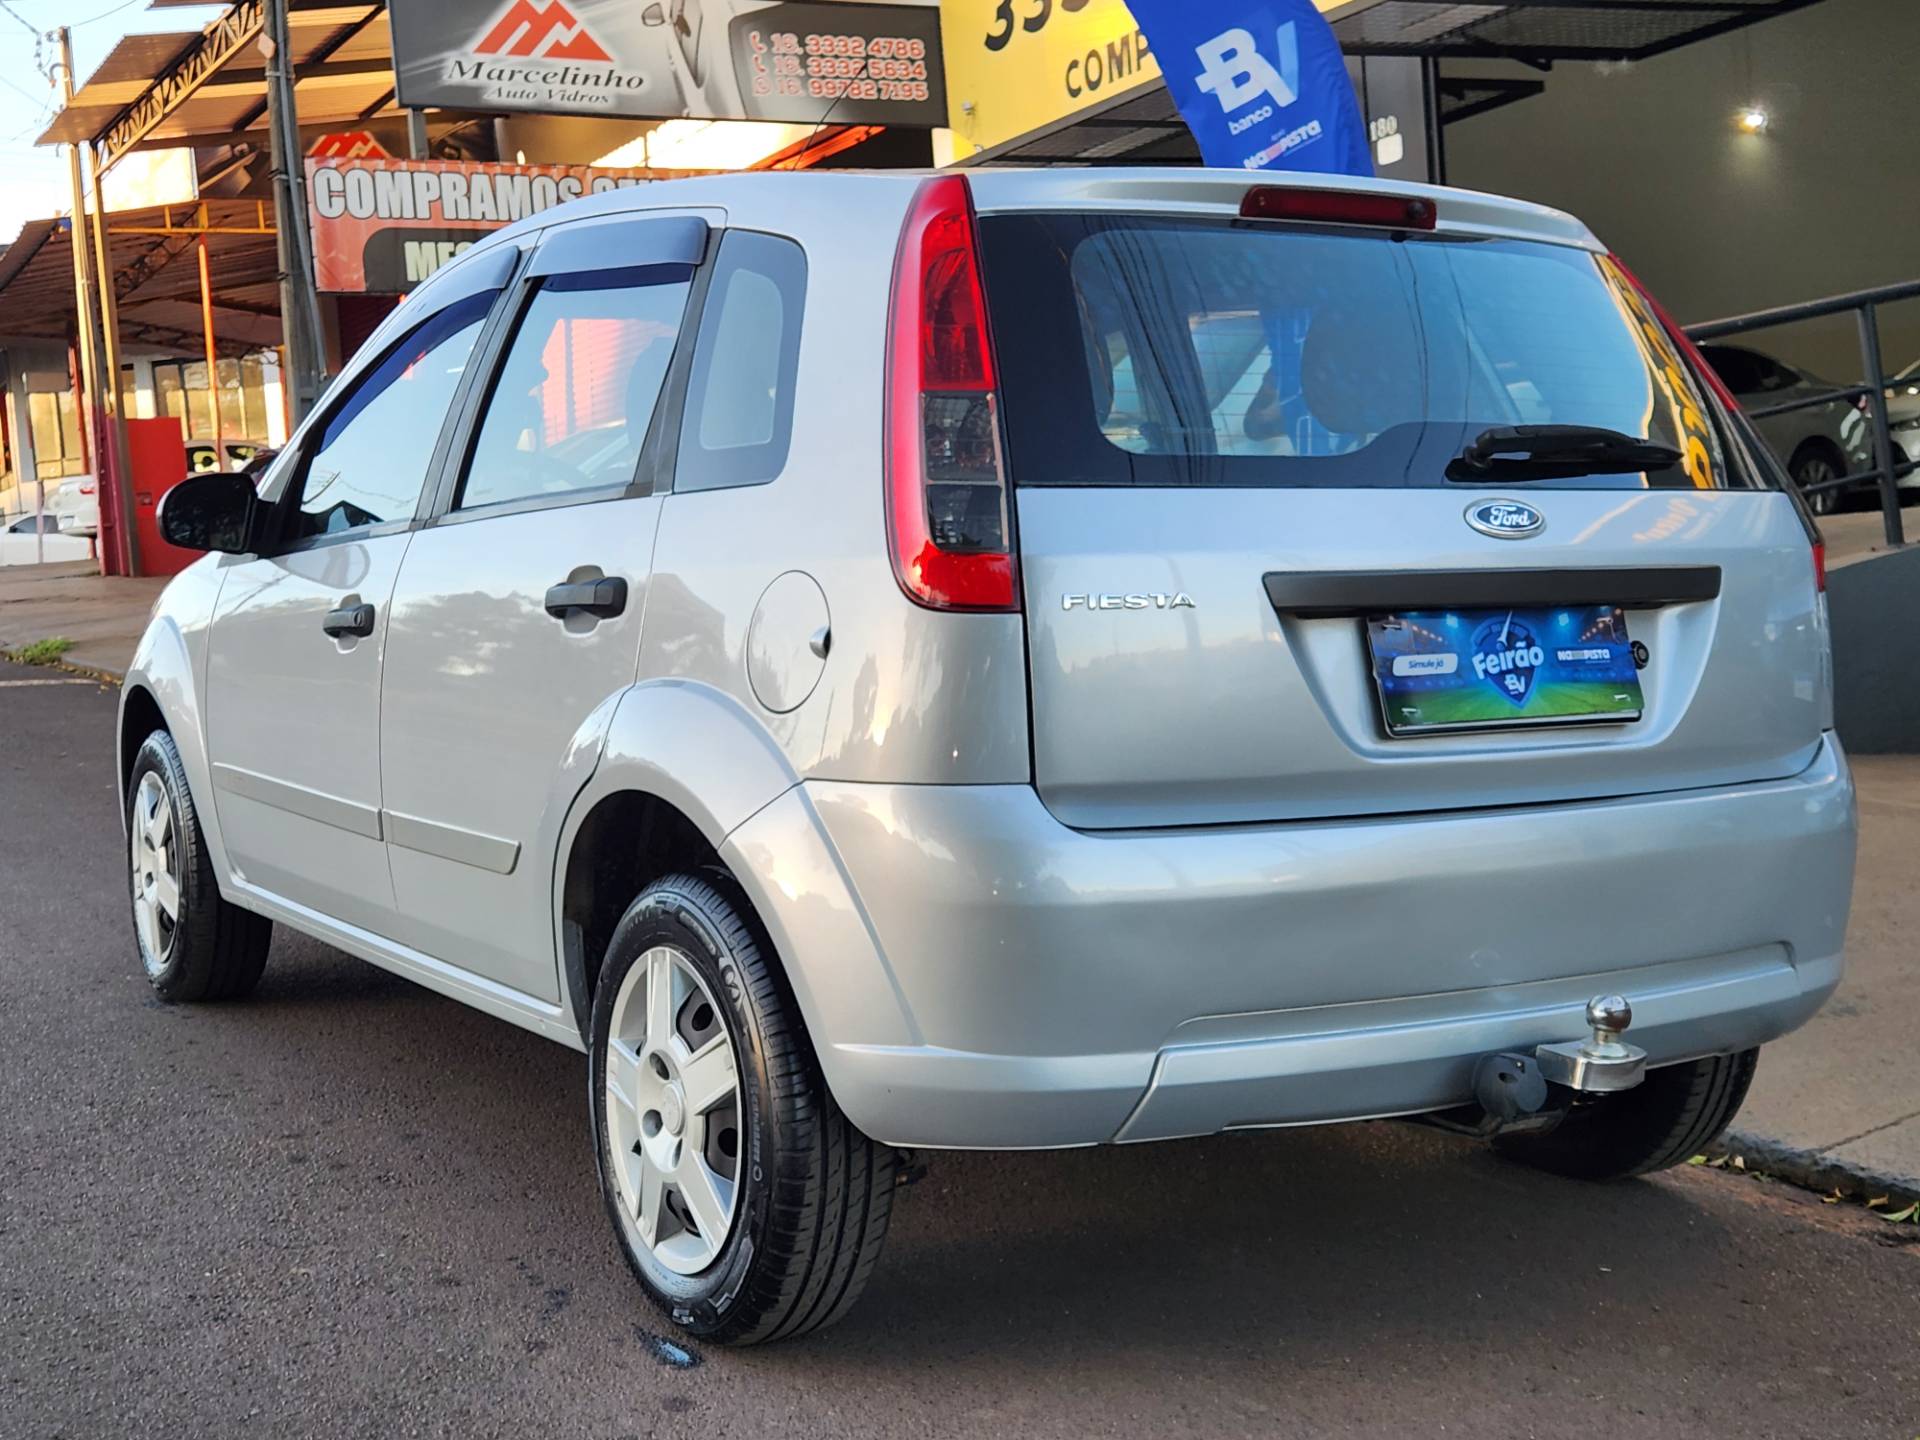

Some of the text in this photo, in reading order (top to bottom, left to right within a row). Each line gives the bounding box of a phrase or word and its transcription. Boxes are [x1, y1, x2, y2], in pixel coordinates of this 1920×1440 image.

[805, 34, 865, 56] 3332
[449, 60, 644, 89] Marcelinho
[1195, 20, 1298, 113] BV
[488, 87, 609, 104] Auto Vidros
[878, 80, 928, 101] 7195
[1228, 105, 1273, 135] banco
[1370, 115, 1397, 141] 180
[313, 167, 583, 221] COMPRAMOS
[1489, 506, 1530, 525] Ford
[1061, 592, 1196, 611] FIESTA
[1408, 660, 1434, 669] Simule
[1471, 641, 1544, 679] Feirão
